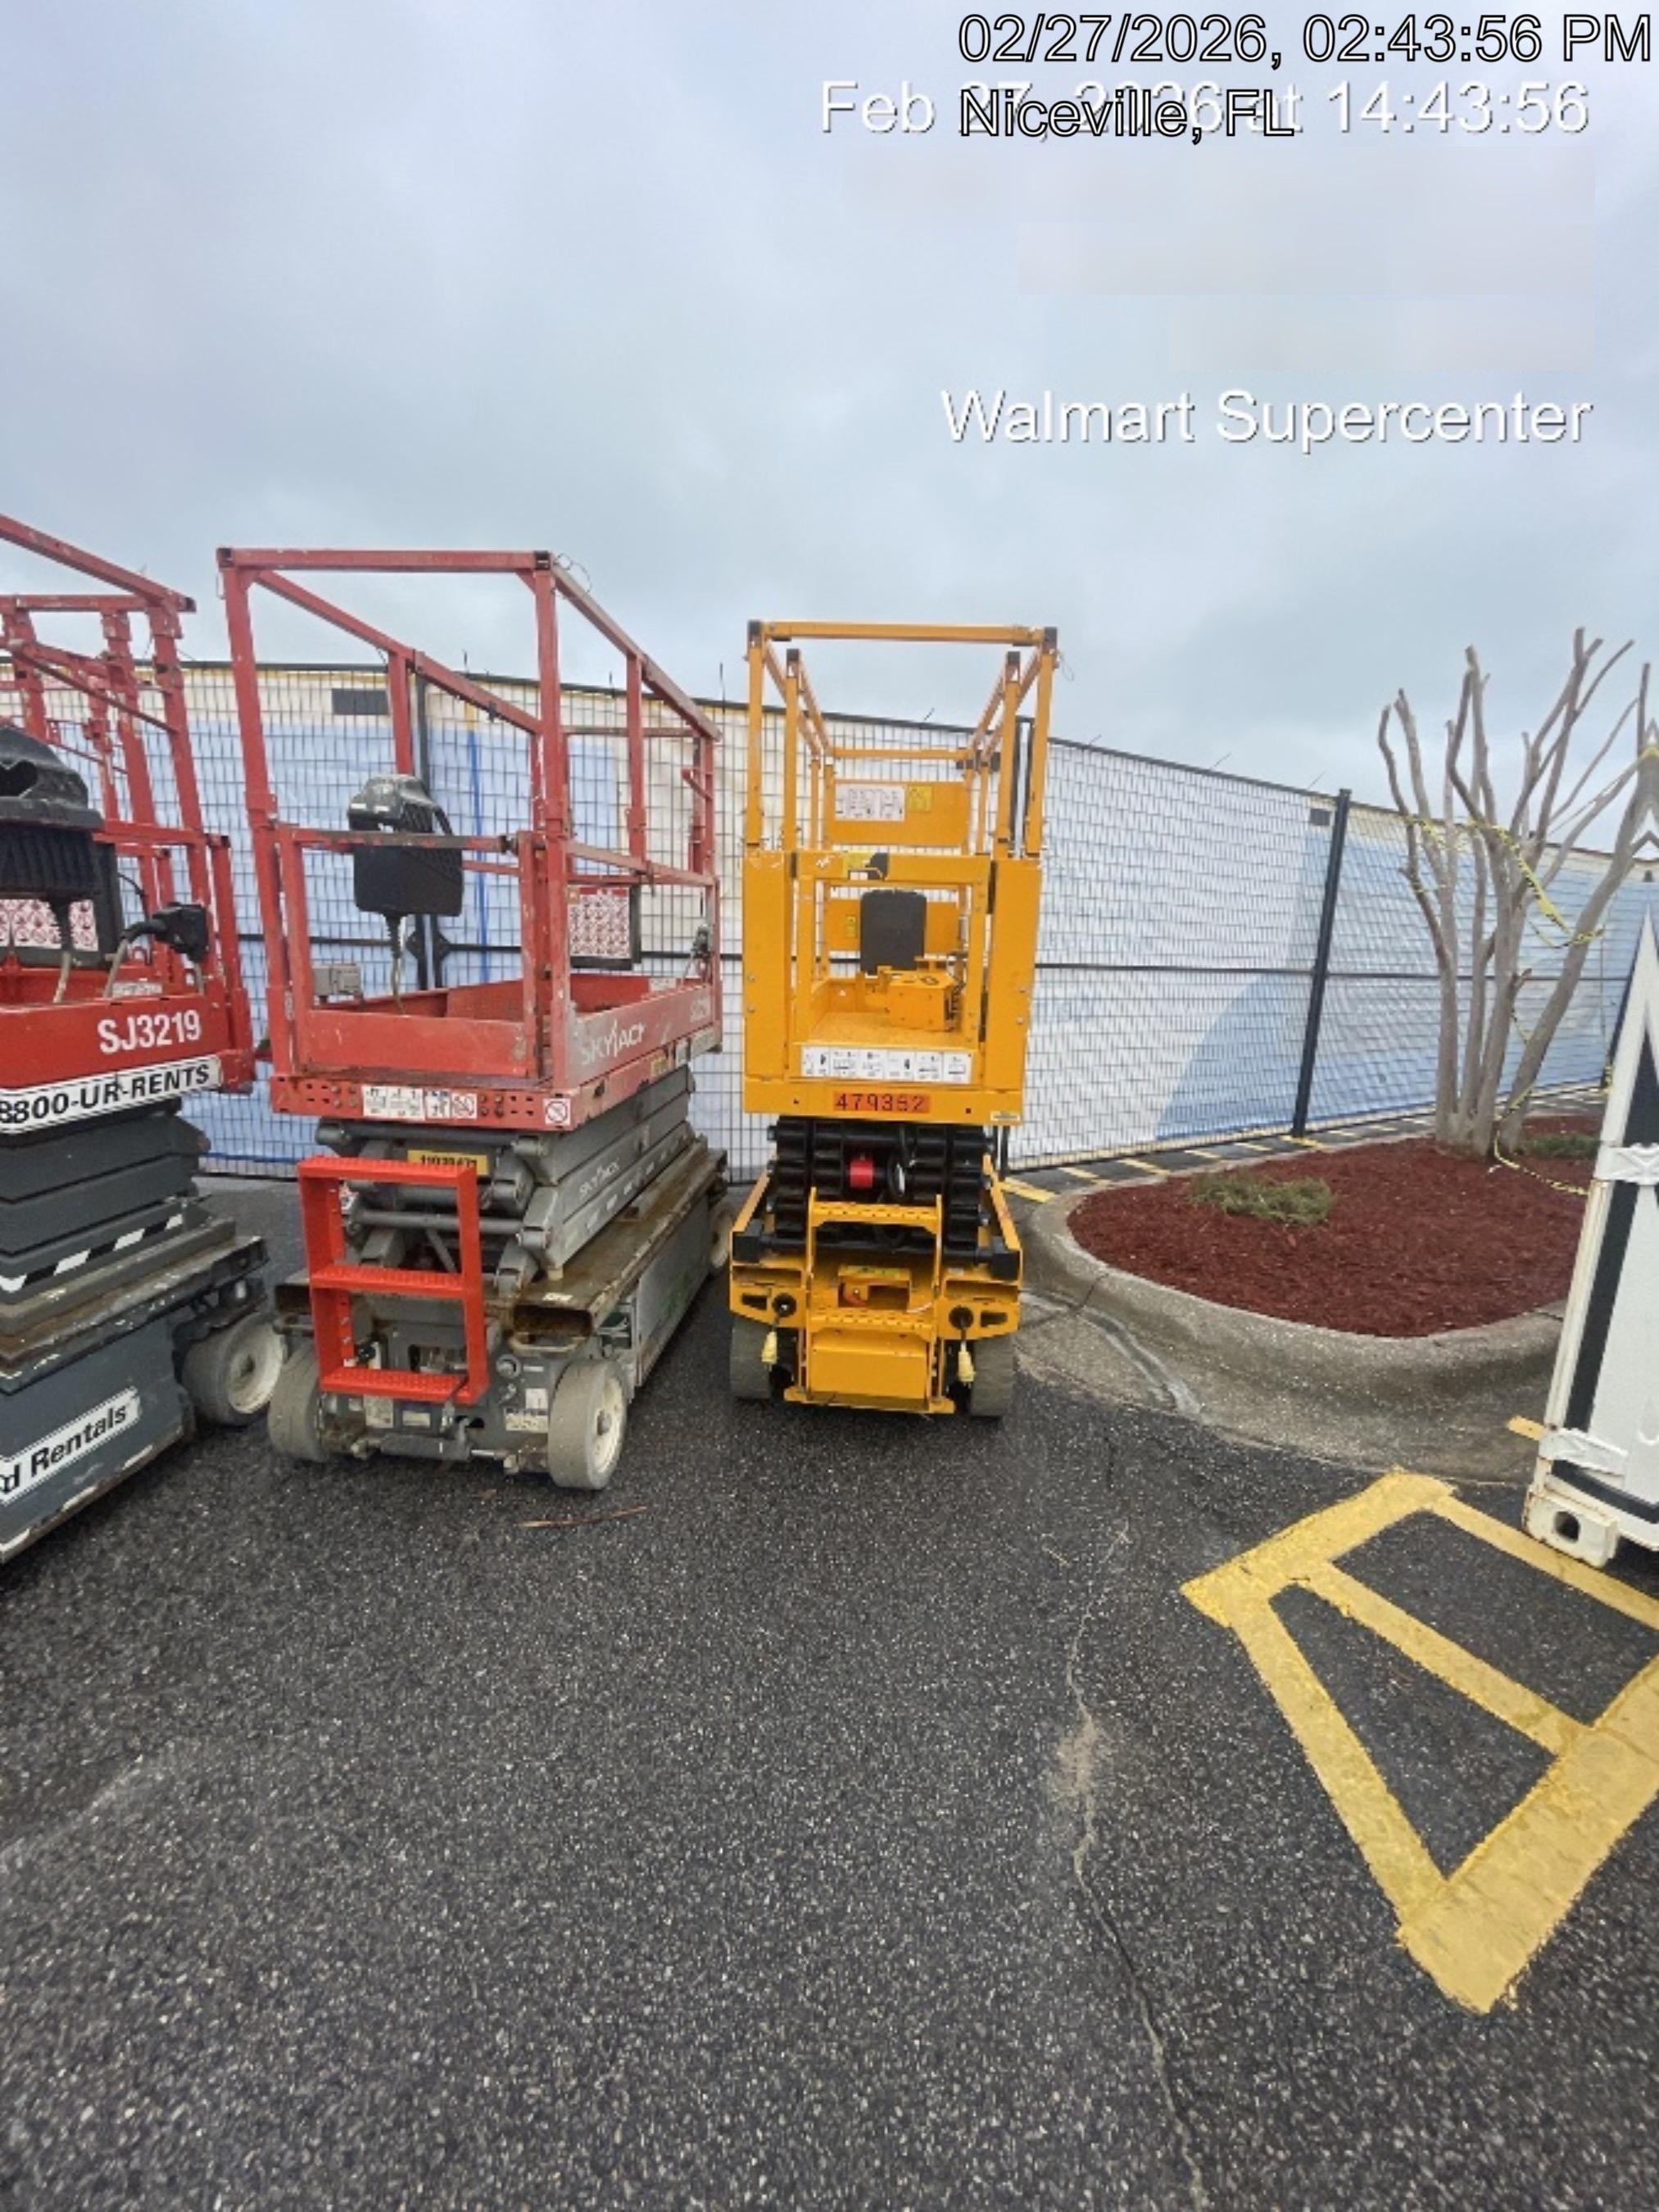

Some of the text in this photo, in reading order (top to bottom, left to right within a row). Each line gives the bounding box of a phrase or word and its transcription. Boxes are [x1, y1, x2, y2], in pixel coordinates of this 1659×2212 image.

[97, 1009, 202, 1054] SJ3219
[834, 1092, 925, 1112] 479352
[30, 1404, 127, 1477] Rentals
